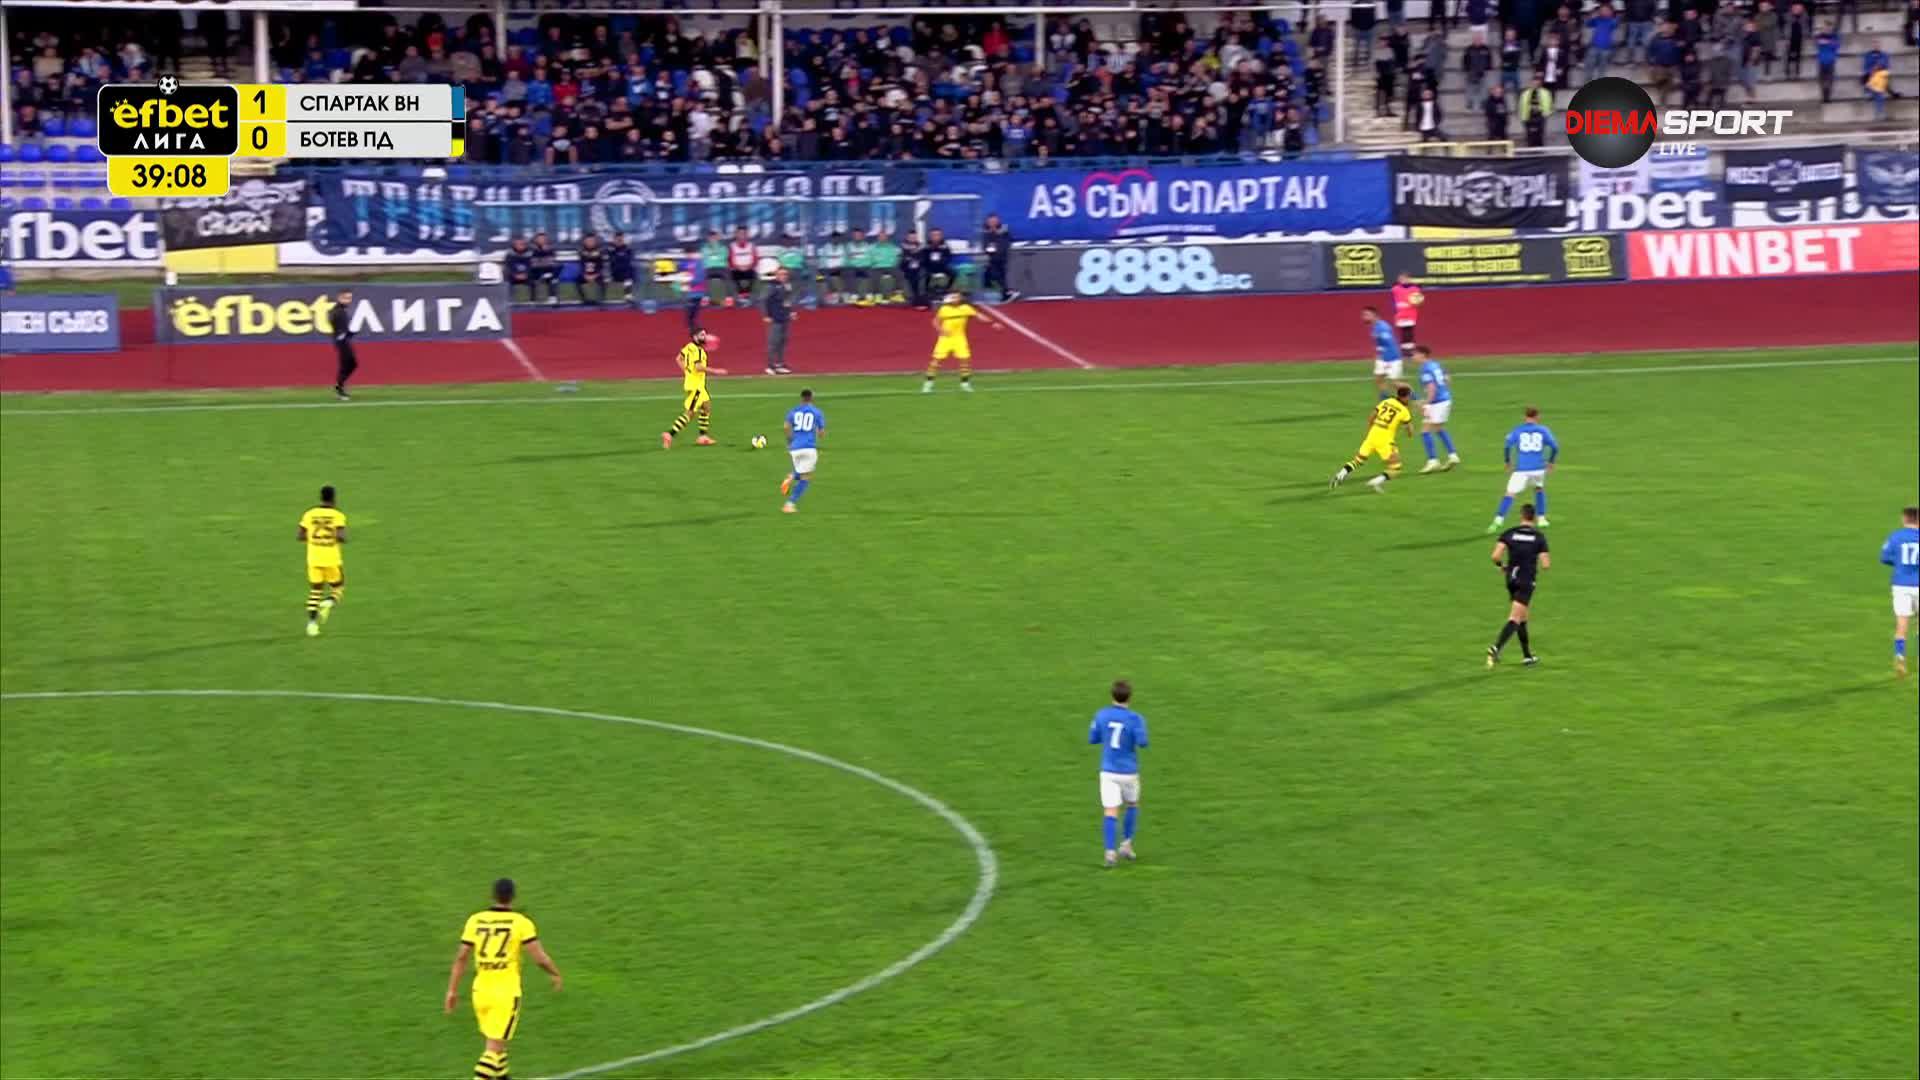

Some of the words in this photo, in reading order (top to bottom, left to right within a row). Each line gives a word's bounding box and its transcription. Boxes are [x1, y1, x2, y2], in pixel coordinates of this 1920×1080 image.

[1028, 184, 1076, 219] АЗ
[1084, 181, 1159, 218] СЪМ
[1168, 175, 1329, 214] СПАРТАК
[0, 212, 159, 260] fbet
[1643, 227, 1862, 278] WINBET
[170, 294, 337, 337] efbet
[349, 297, 503, 332] ЛИГА
[793, 412, 814, 431] 90
[1379, 404, 1398, 424] 23
[1518, 431, 1544, 452] 88
[1901, 542, 1919, 565] 17
[1107, 720, 1124, 749] 7
[476, 927, 511, 957] 77
